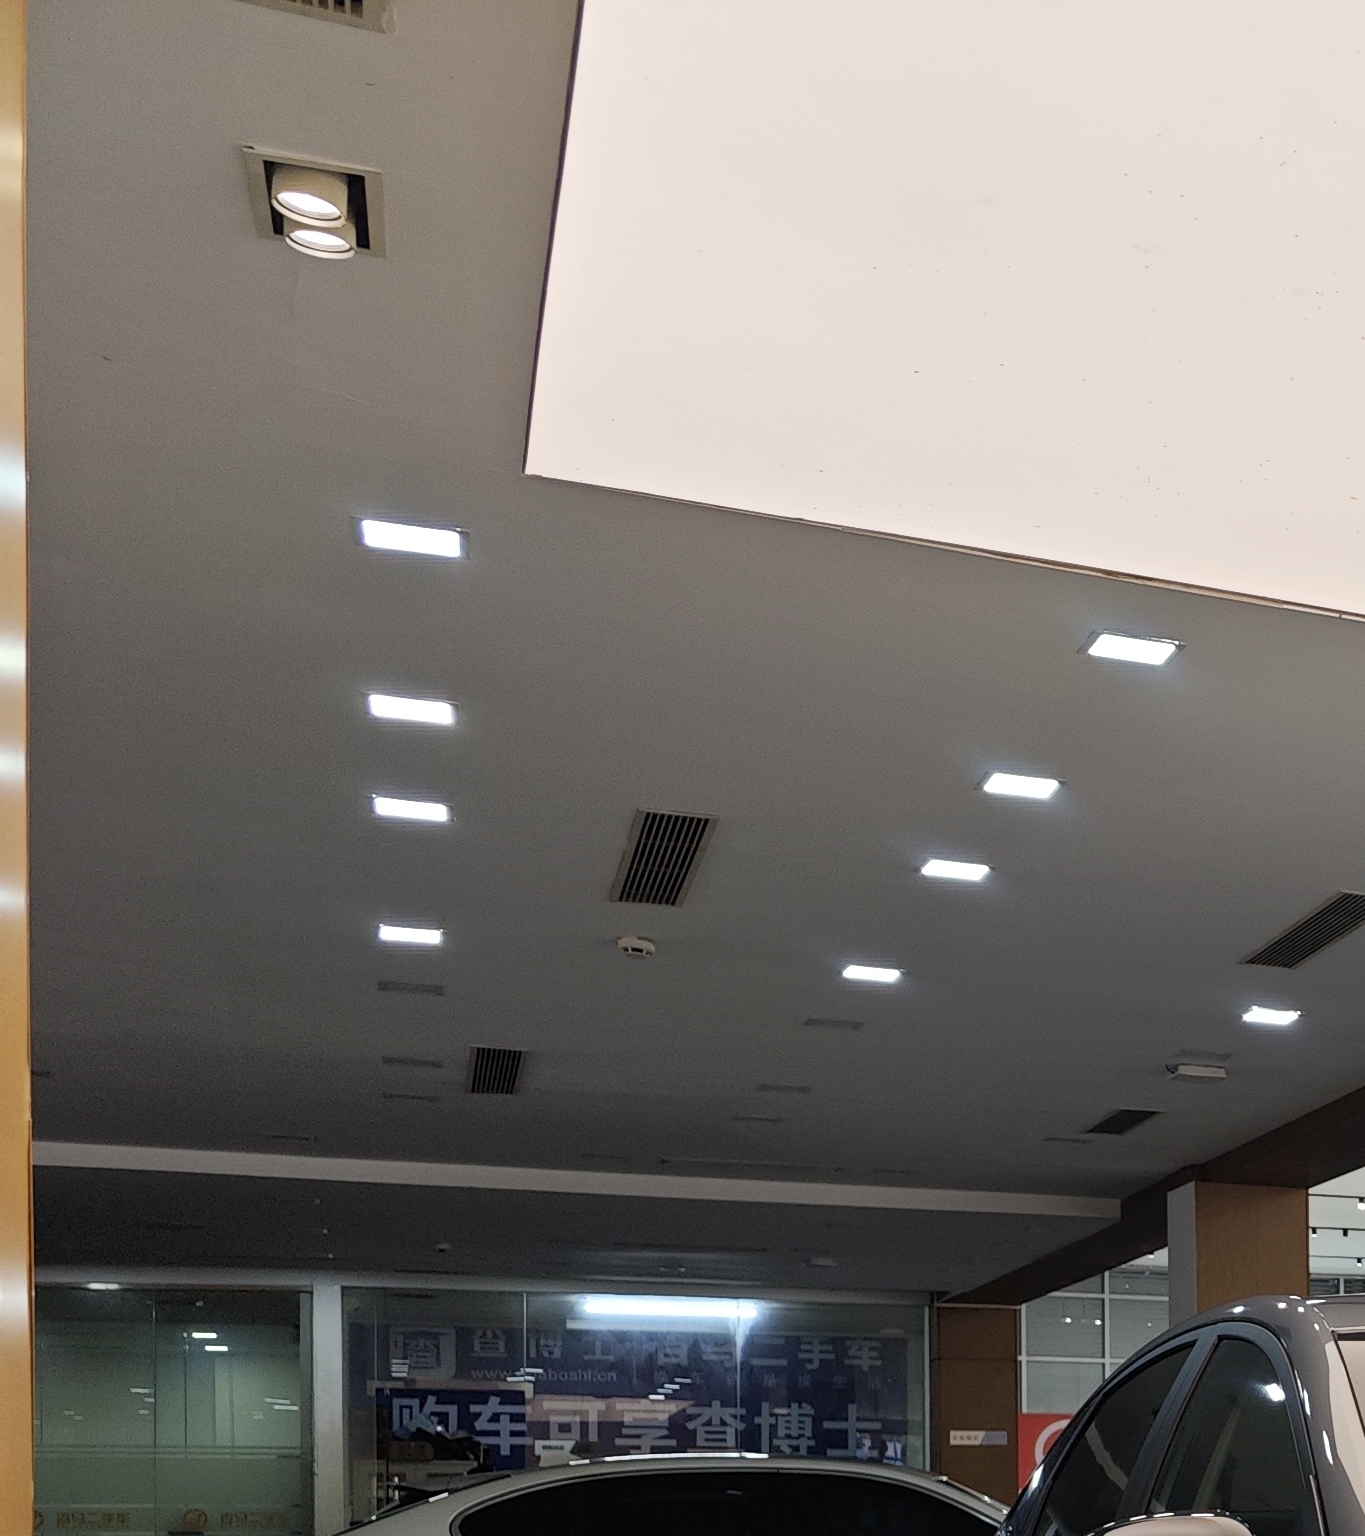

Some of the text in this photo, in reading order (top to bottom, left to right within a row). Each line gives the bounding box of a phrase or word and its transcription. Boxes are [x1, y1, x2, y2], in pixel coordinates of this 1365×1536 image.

[391, 1395, 884, 1457] 购车可享查博士
